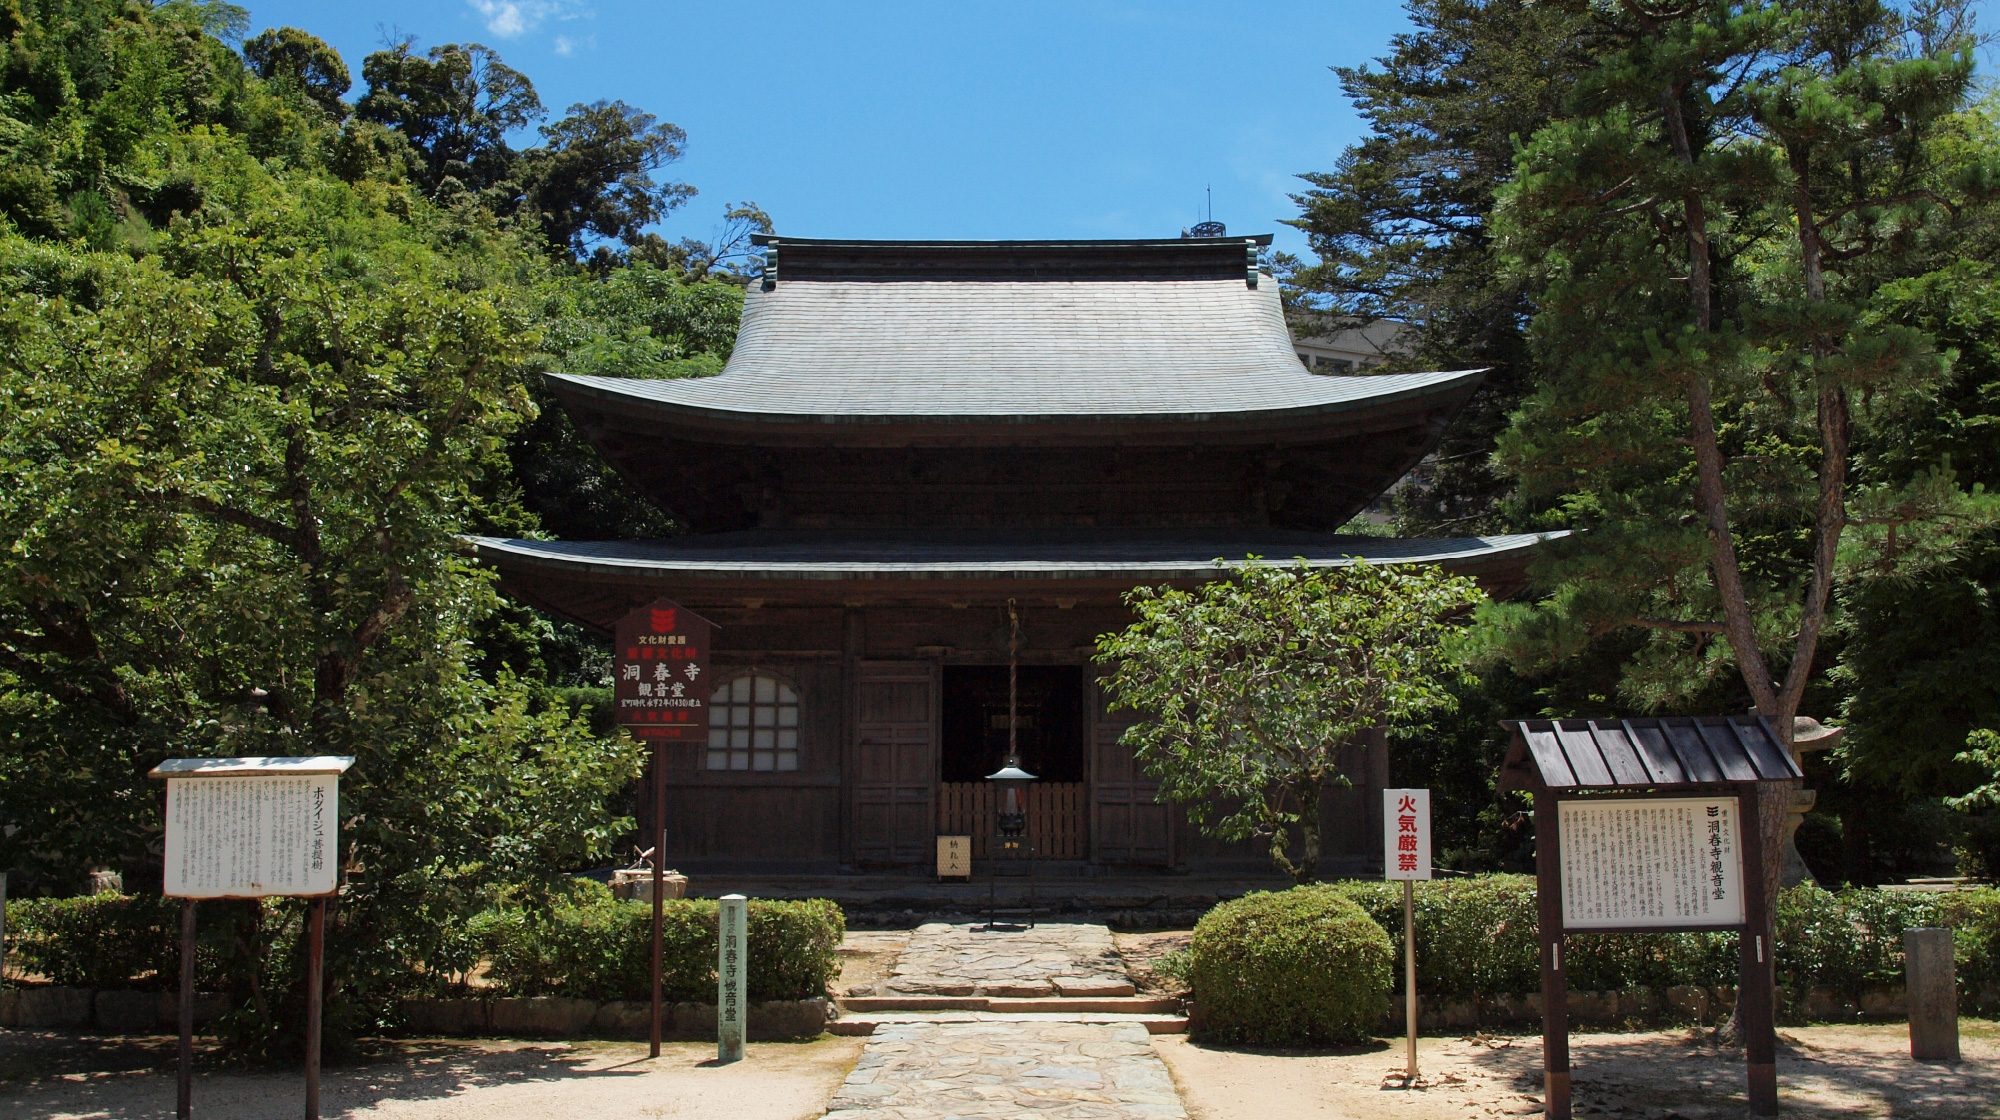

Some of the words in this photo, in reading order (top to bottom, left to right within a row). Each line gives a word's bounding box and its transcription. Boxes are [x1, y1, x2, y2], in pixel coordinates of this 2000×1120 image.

[638, 635, 686, 645] 文化財愛護
[622, 662, 701, 682] 洞春寺
[621, 698, 646, 708] 室町時代
[638, 682, 686, 698] 観音堂
[1397, 795, 1418, 872] 火気厳禁
[1721, 808, 1731, 854] 重要文化財
[1707, 820, 1726, 900] 洞春寺観音堂
[724, 935, 738, 1022] 洞春寺観音堂
